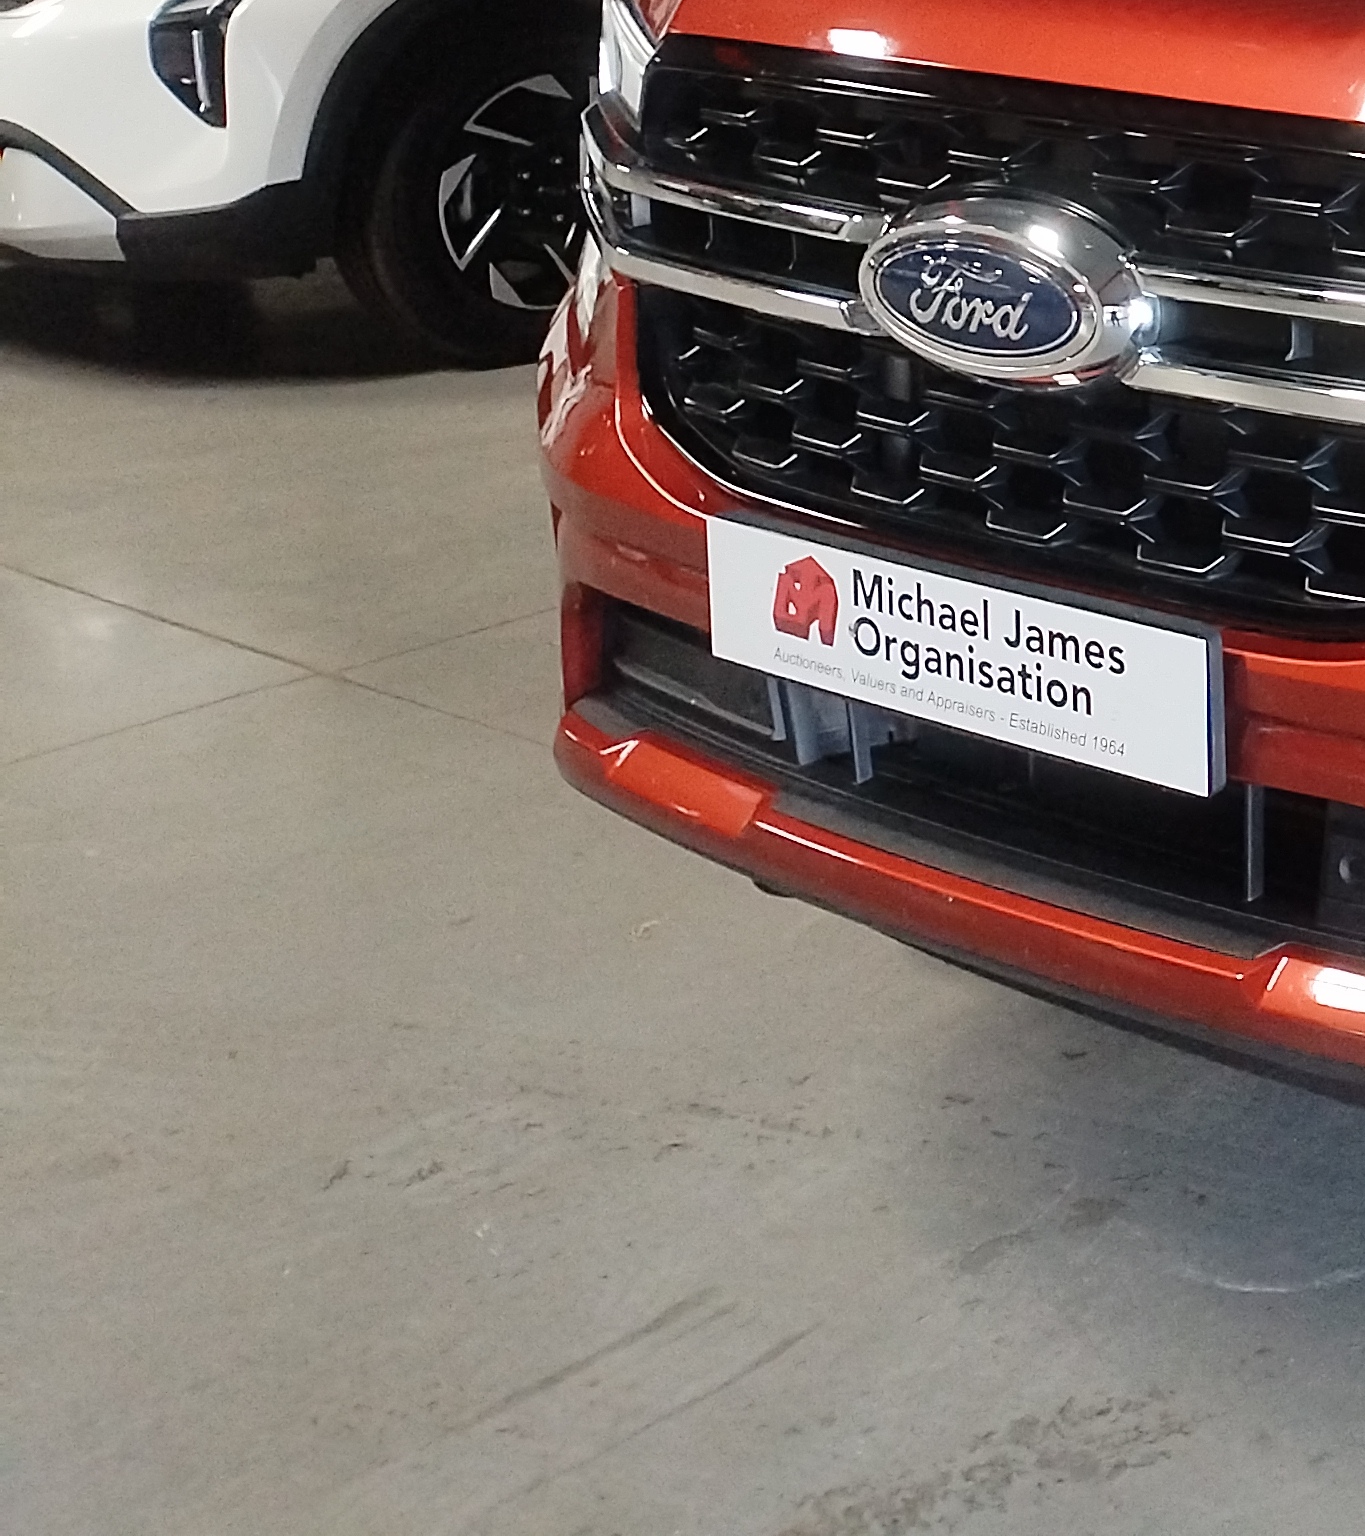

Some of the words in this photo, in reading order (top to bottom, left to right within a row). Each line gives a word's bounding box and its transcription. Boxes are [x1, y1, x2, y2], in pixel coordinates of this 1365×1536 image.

[909, 257, 1033, 343] Ford
[853, 568, 989, 641] Michael
[1003, 609, 1125, 674] James
[853, 617, 1092, 716] Organisation
[851, 668, 896, 694] Valuers
[900, 686, 924, 702] and
[927, 691, 996, 722] Appraisers
[1009, 713, 1087, 747] Established
[1092, 736, 1126, 757] 1964
